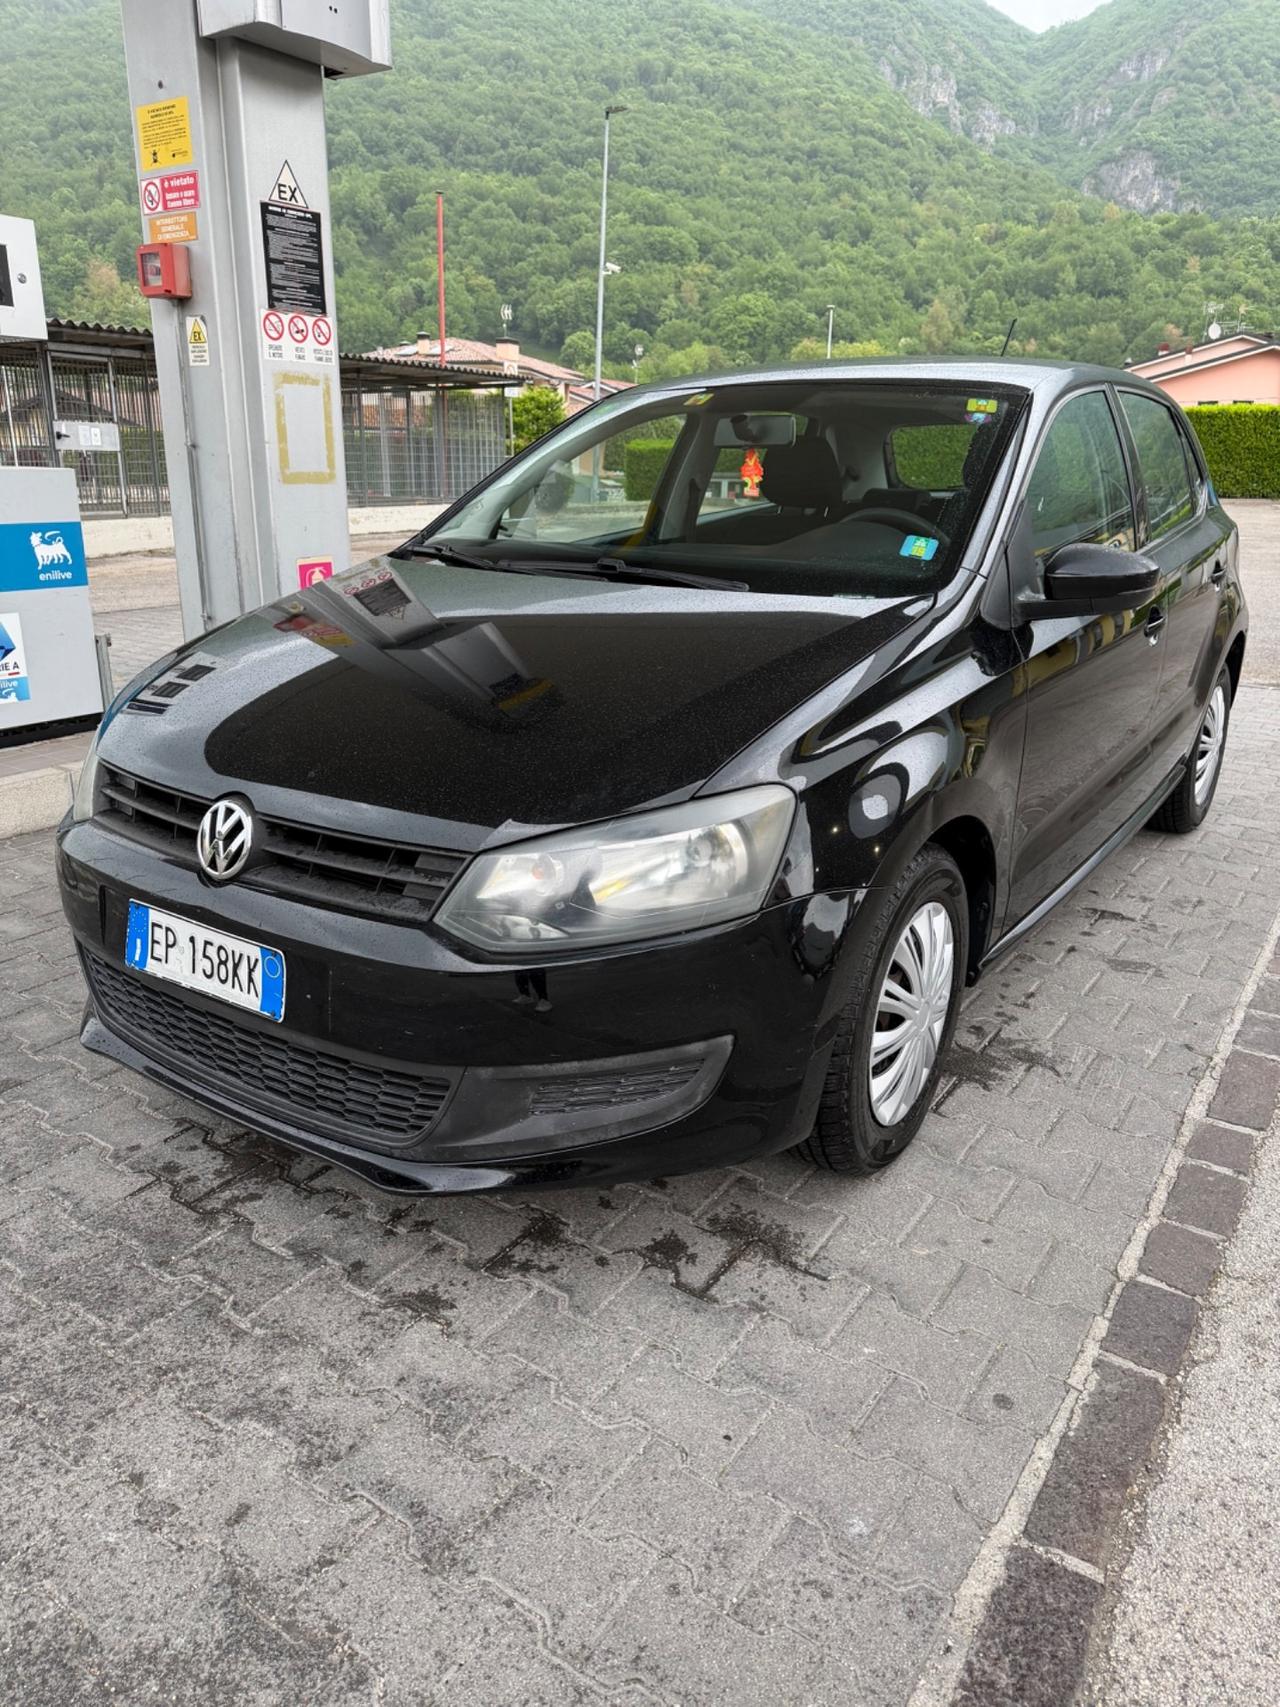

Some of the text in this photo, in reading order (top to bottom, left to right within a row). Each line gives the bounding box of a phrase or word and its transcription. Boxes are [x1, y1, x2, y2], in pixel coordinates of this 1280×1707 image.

[170, 176, 195, 187] vietato
[277, 183, 299, 203] EX
[193, 331, 202, 341] EX
[39, 570, 73, 581] enilive
[13, 661, 20, 670] A
[151, 921, 177, 964] EP
[188, 935, 259, 998] 158KK
